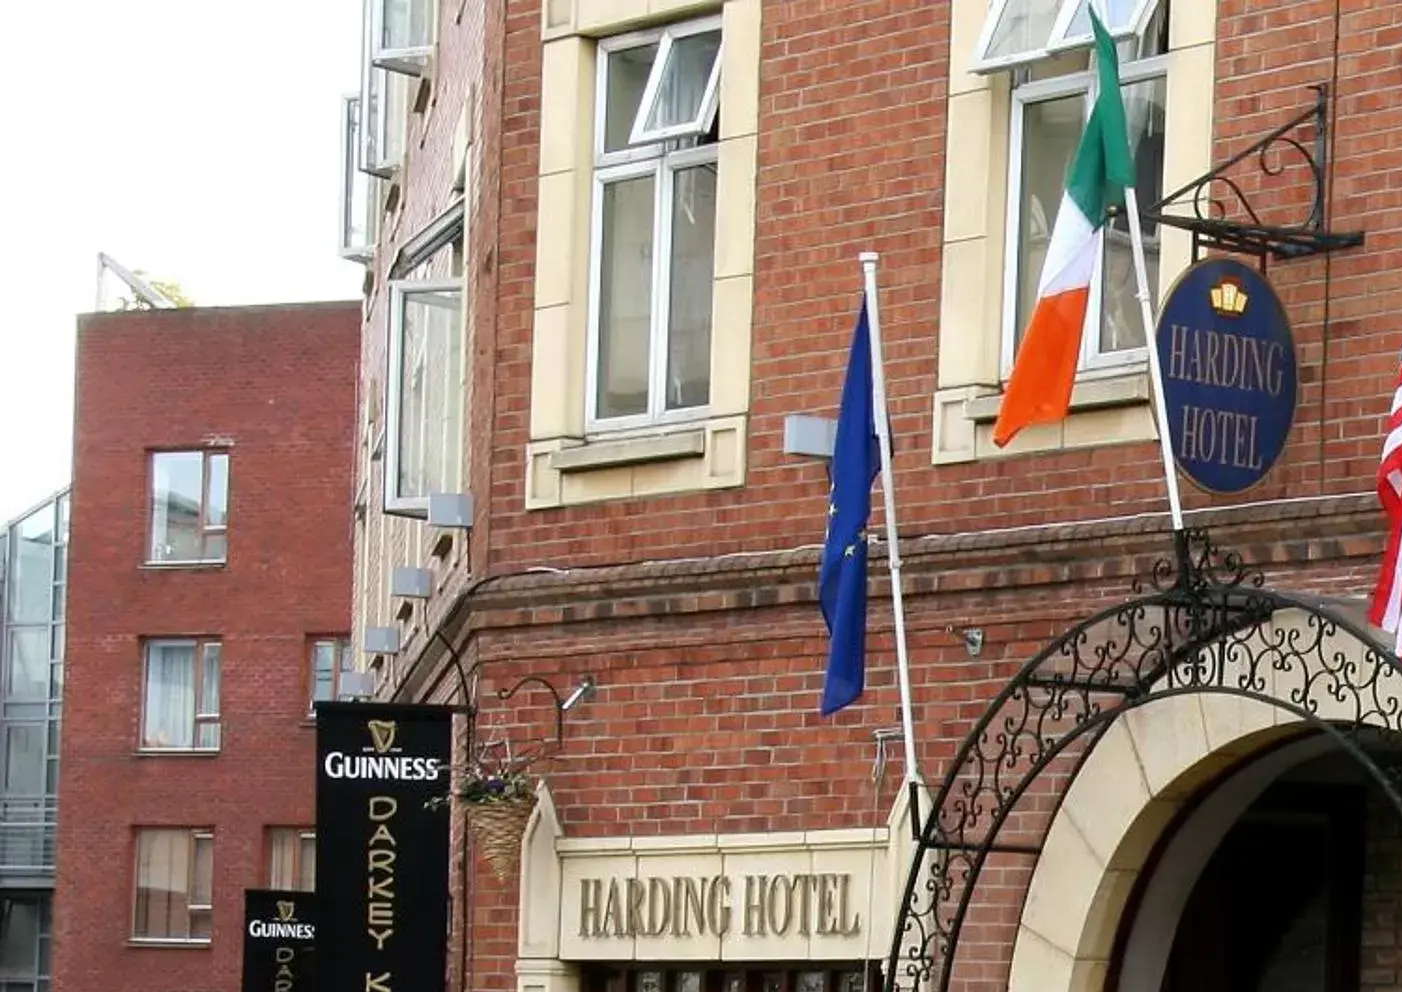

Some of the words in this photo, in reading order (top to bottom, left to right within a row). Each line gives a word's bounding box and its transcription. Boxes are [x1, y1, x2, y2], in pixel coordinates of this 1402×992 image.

[1169, 324, 1284, 397] HARDING
[1181, 404, 1263, 470] HOTEL
[325, 751, 440, 780] GUINNESS
[368, 796, 398, 950] DARKEY
[578, 874, 733, 939] HARDING
[741, 872, 861, 938] HOTEL
